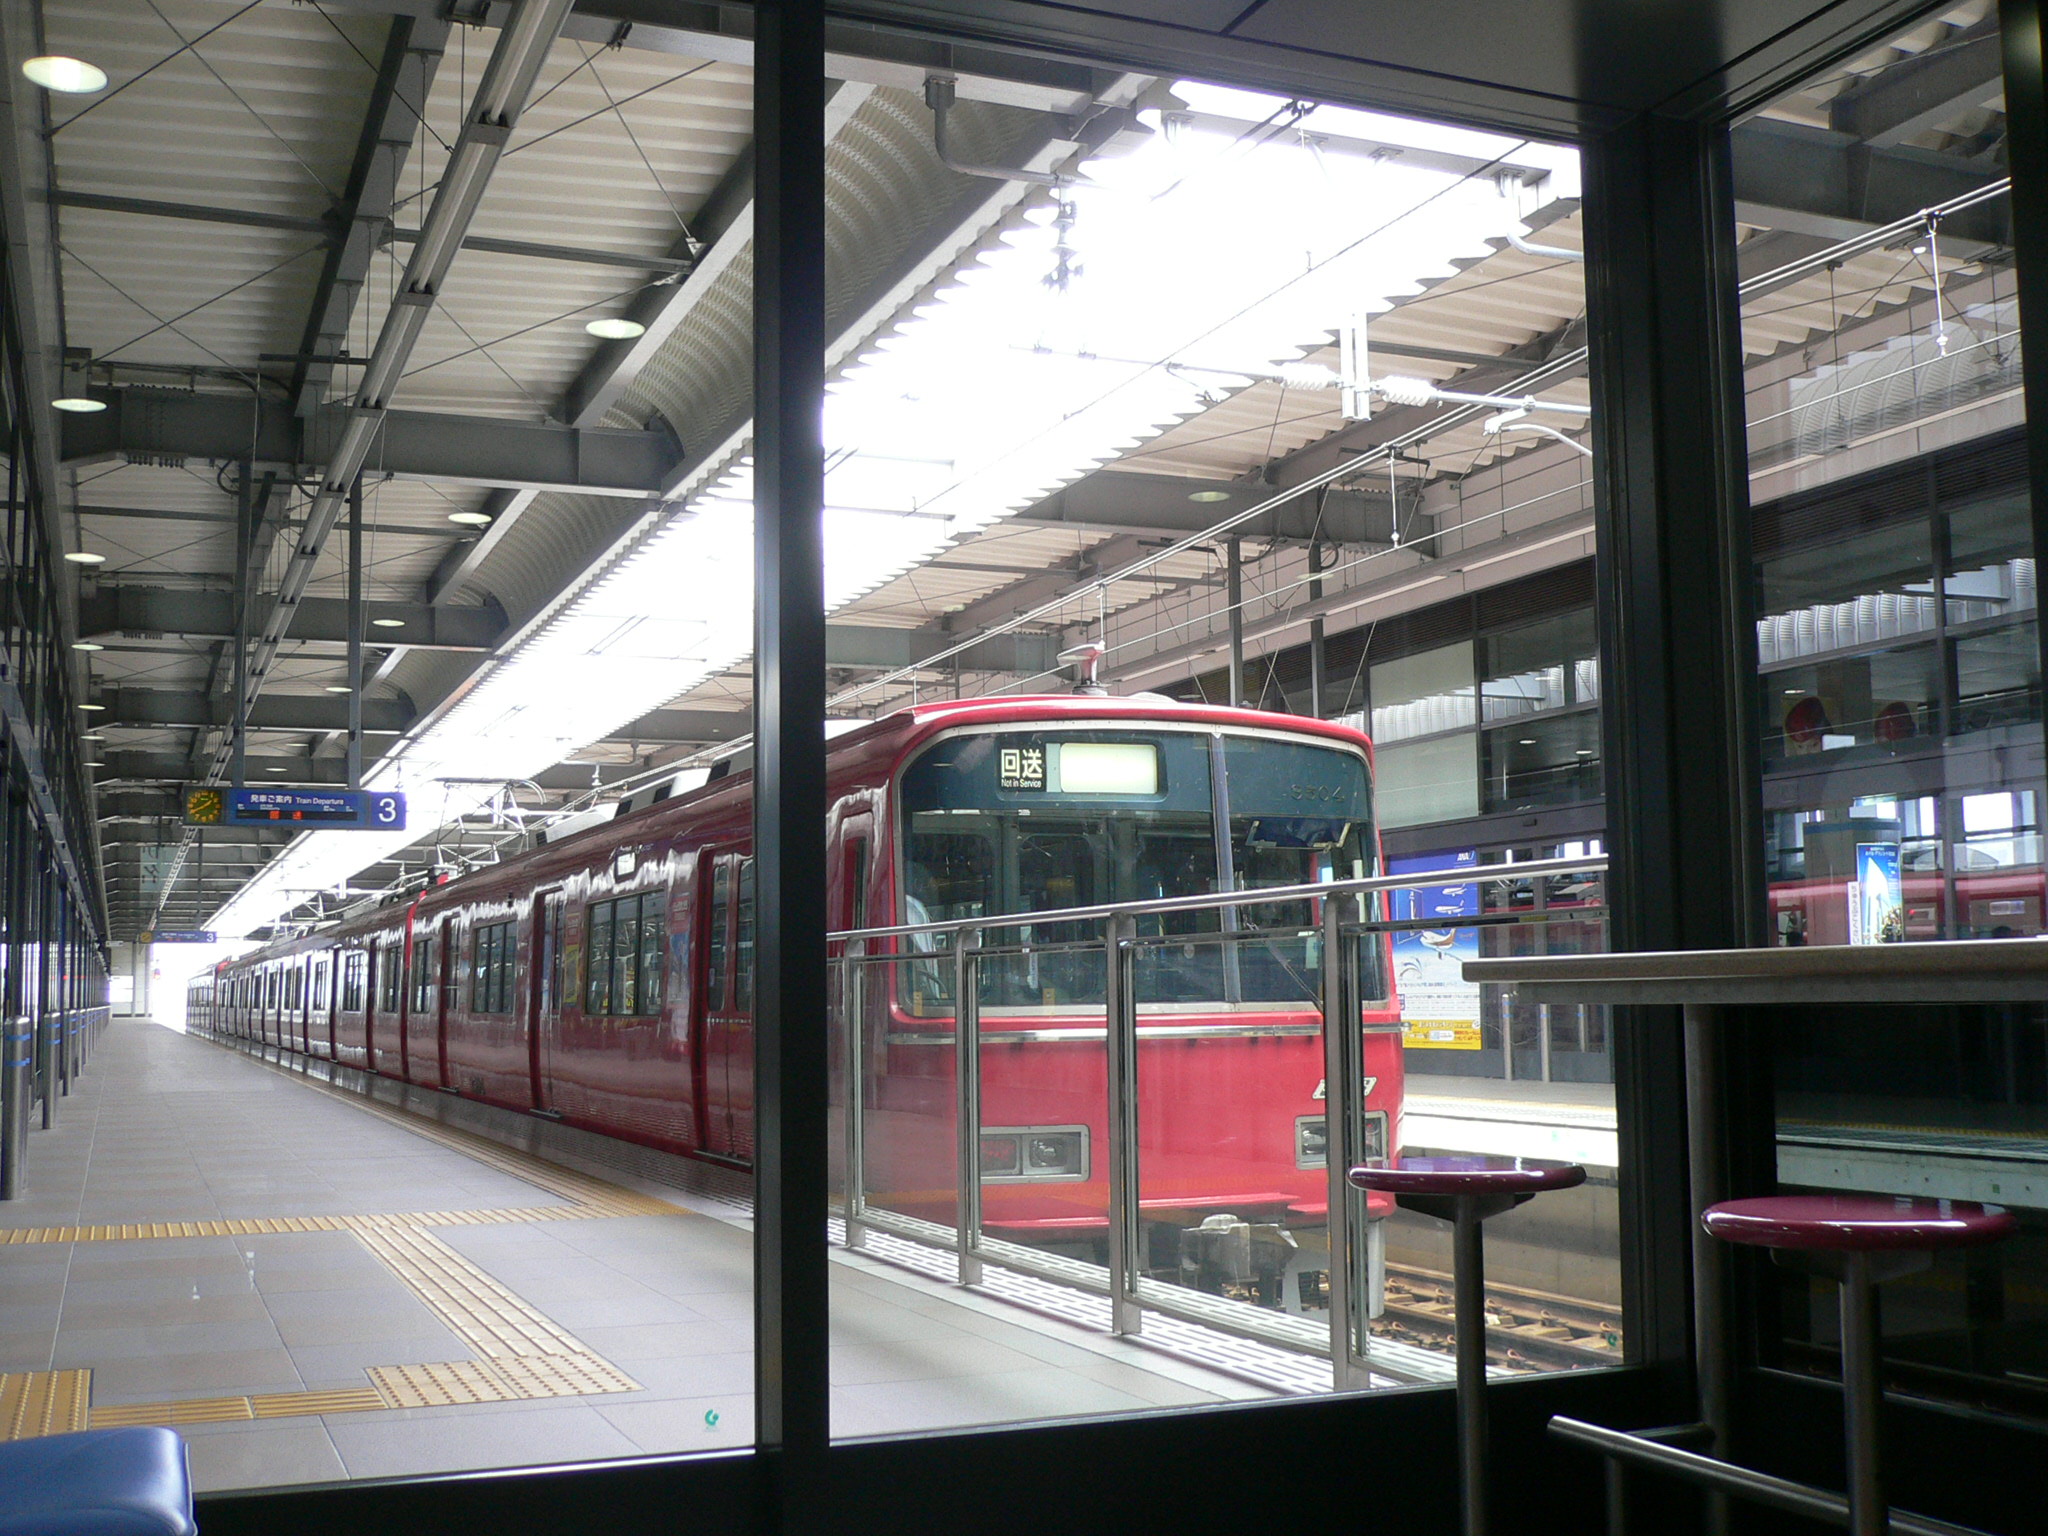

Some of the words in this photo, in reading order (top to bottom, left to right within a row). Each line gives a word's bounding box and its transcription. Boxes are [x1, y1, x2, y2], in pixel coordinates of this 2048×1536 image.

[1001, 748, 1043, 778] 回送
[1001, 779, 1012, 788] Not
[1013, 779, 1019, 788] in
[1019, 779, 1042, 788] Service
[251, 794, 293, 804] 発車ご案内
[313, 798, 344, 806] Departure
[378, 798, 396, 822] 3
[206, 933, 214, 942] 3
